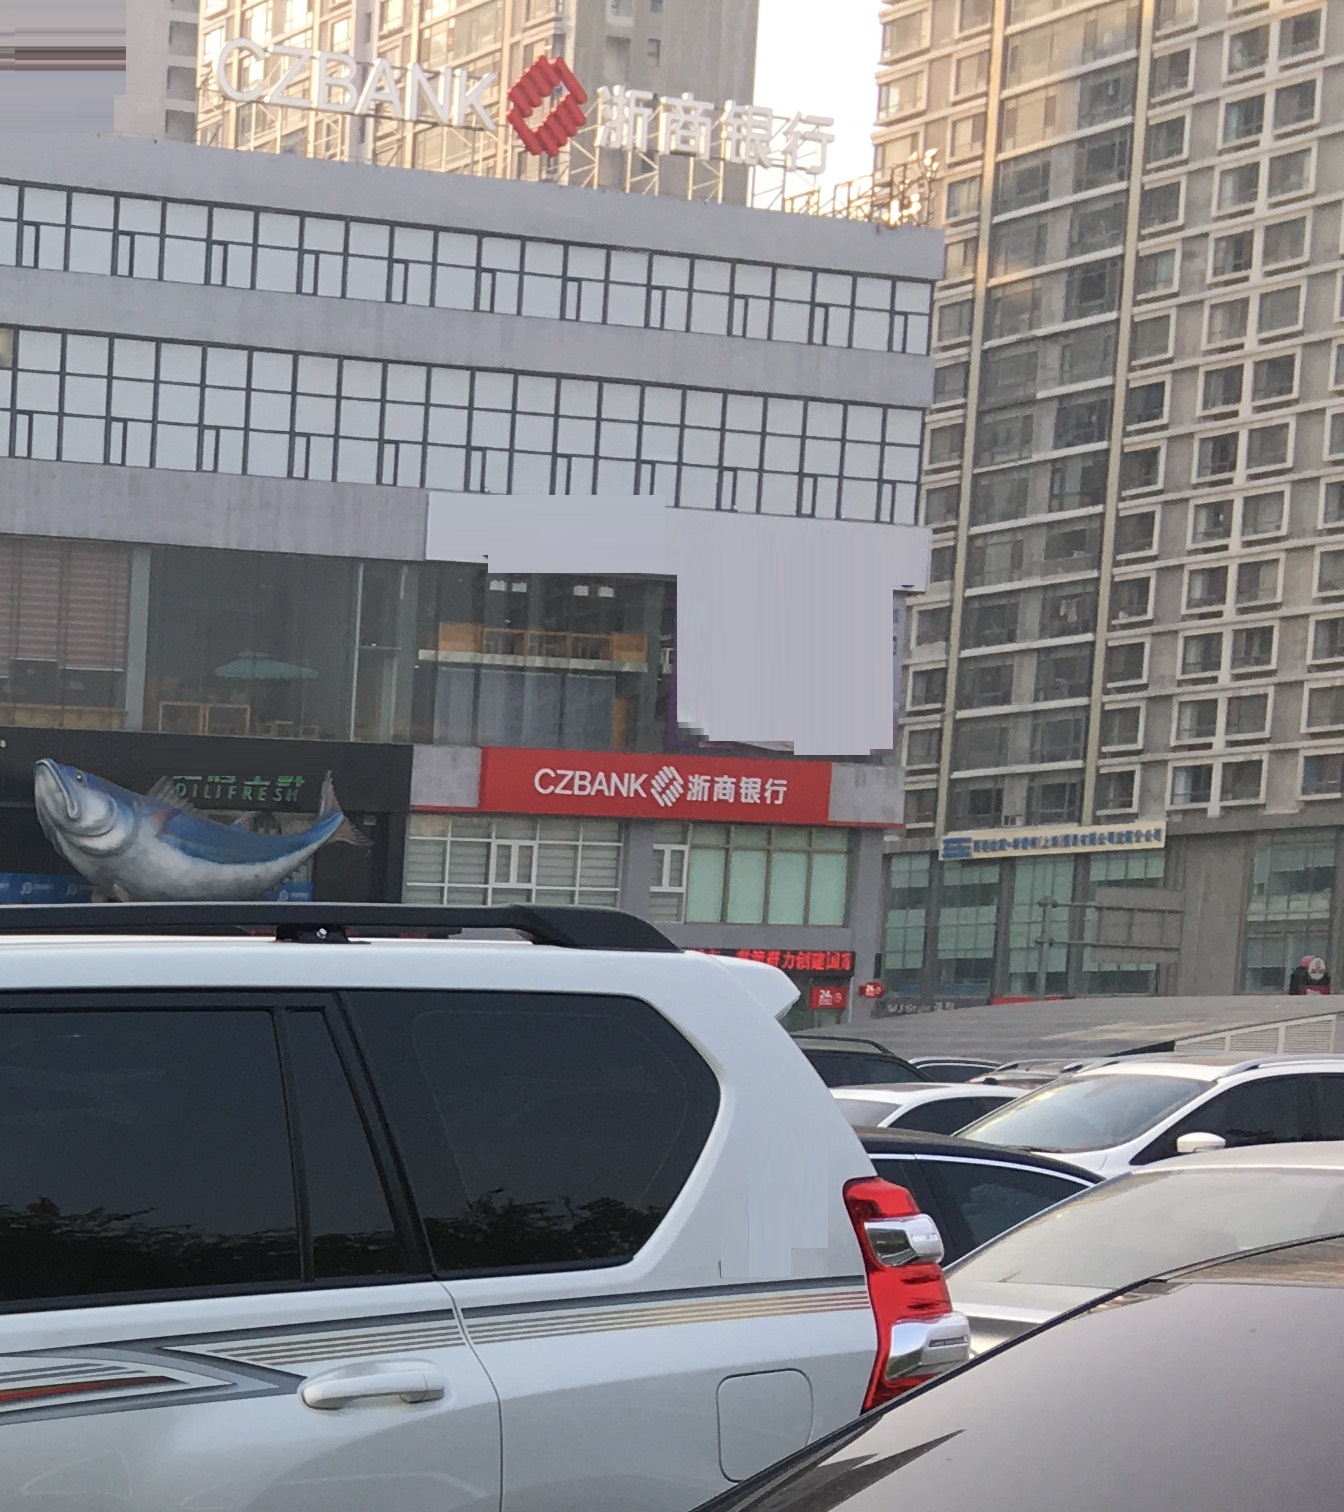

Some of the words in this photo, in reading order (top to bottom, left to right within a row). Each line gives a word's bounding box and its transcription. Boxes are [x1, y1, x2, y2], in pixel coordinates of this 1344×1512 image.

[217, 38, 497, 130] CZBANK
[597, 84, 835, 175] 浙商银行
[174, 782, 300, 802] DILIFRESH
[534, 768, 648, 798] CZBANK
[686, 773, 788, 805] 浙商银行
